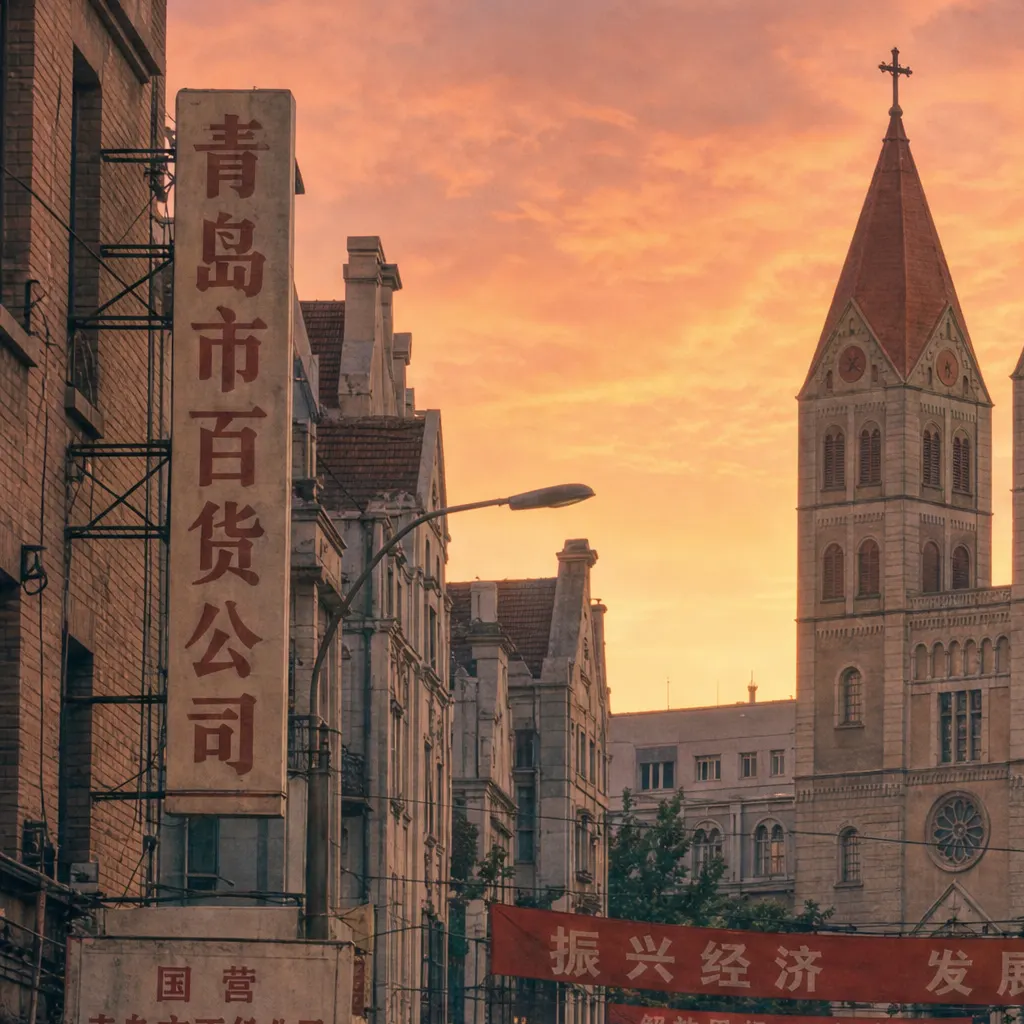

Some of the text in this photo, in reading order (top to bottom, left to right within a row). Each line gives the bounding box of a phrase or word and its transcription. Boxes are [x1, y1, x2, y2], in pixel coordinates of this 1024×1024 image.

[185, 113, 271, 775] 青岛市百货公司
[157, 965, 256, 1004] 国营
[549, 925, 823, 993] 振兴经济
